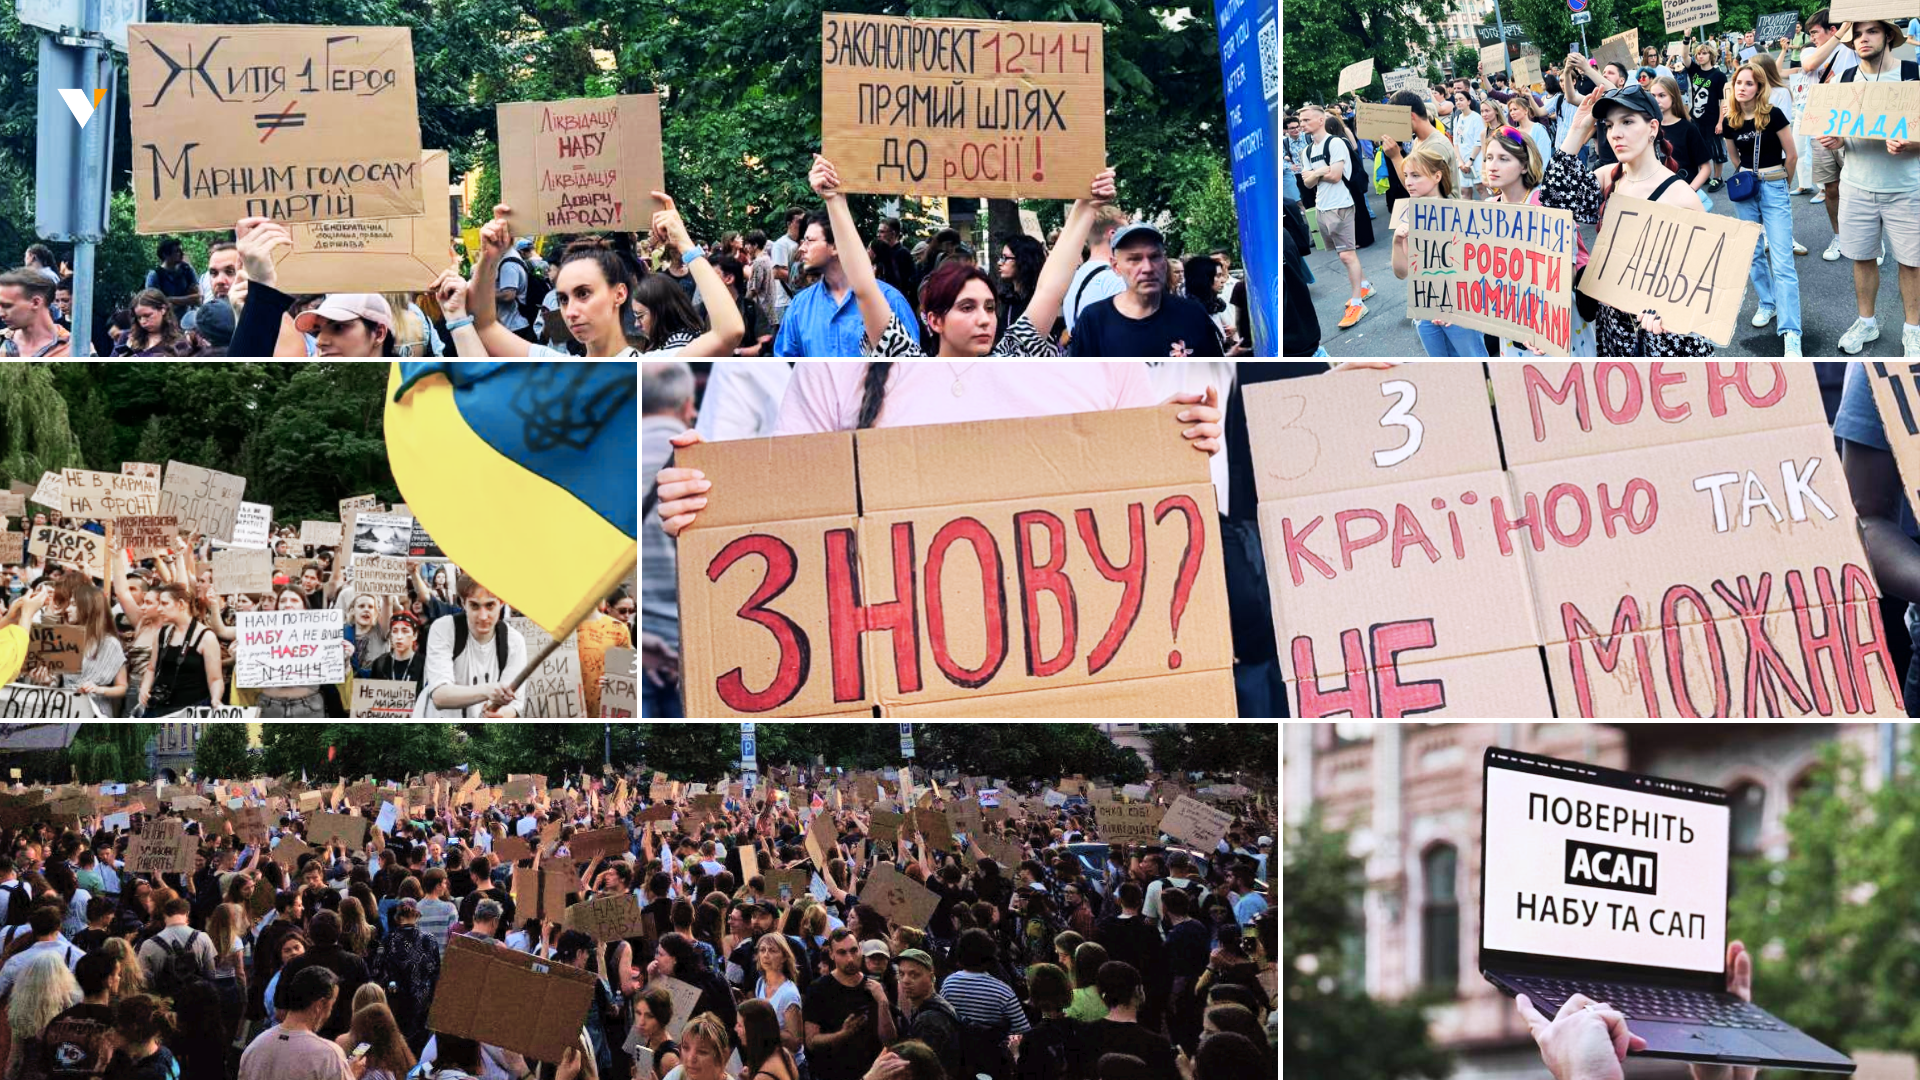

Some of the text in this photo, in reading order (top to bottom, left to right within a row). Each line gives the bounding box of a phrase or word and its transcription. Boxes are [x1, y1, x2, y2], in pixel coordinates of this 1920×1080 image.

[825, 20, 1090, 74] ЗАКОНОПРОЄКТ 12414
[1223, 18, 1250, 63] FOR YOU
[296, 57, 319, 92] 1
[1227, 62, 1246, 97] AFTER
[858, 80, 1067, 131] ПРЯМИЙ ШЛЯХ
[1229, 104, 1242, 129] THE
[1823, 109, 1908, 139] ЗРАДА
[558, 132, 606, 159] НАБУ
[877, 137, 928, 182] ДО
[1233, 127, 1264, 163] VICTORY!
[547, 202, 622, 227] НАРОДУ!
[1414, 203, 1572, 253] НАГАДУВАННЯ:
[1414, 237, 1562, 294] ЧАС РОБОТИ
[1597, 210, 1726, 315] ГАНЬБА
[1412, 279, 1571, 350] НАД ПОМИЛКАМИ
[1372, 379, 1425, 469] З
[66, 471, 86, 487] НЕ
[92, 474, 103, 487] В
[112, 475, 157, 493] КАРМАН
[70, 494, 156, 515] НА ФРОНТ
[1281, 456, 1838, 588] КРАЇНОЮ ТАК
[37, 528, 97, 552] ЯКОГО
[245, 611, 338, 628] НАМ ПОТРІБНО
[706, 494, 1206, 712] ЗНОВУ?
[245, 629, 283, 646] НАБУ
[288, 629, 299, 642] А
[303, 629, 318, 641] НЕ
[1291, 563, 1906, 718] НЕ МОЖНА
[542, 657, 569, 675] ВИ
[359, 684, 374, 698] НЕ
[1528, 792, 1695, 844] ПОВЕРНІТЬ
[1569, 847, 1653, 888] АСАП
[1516, 892, 1706, 940] НАБУ ТА САП
